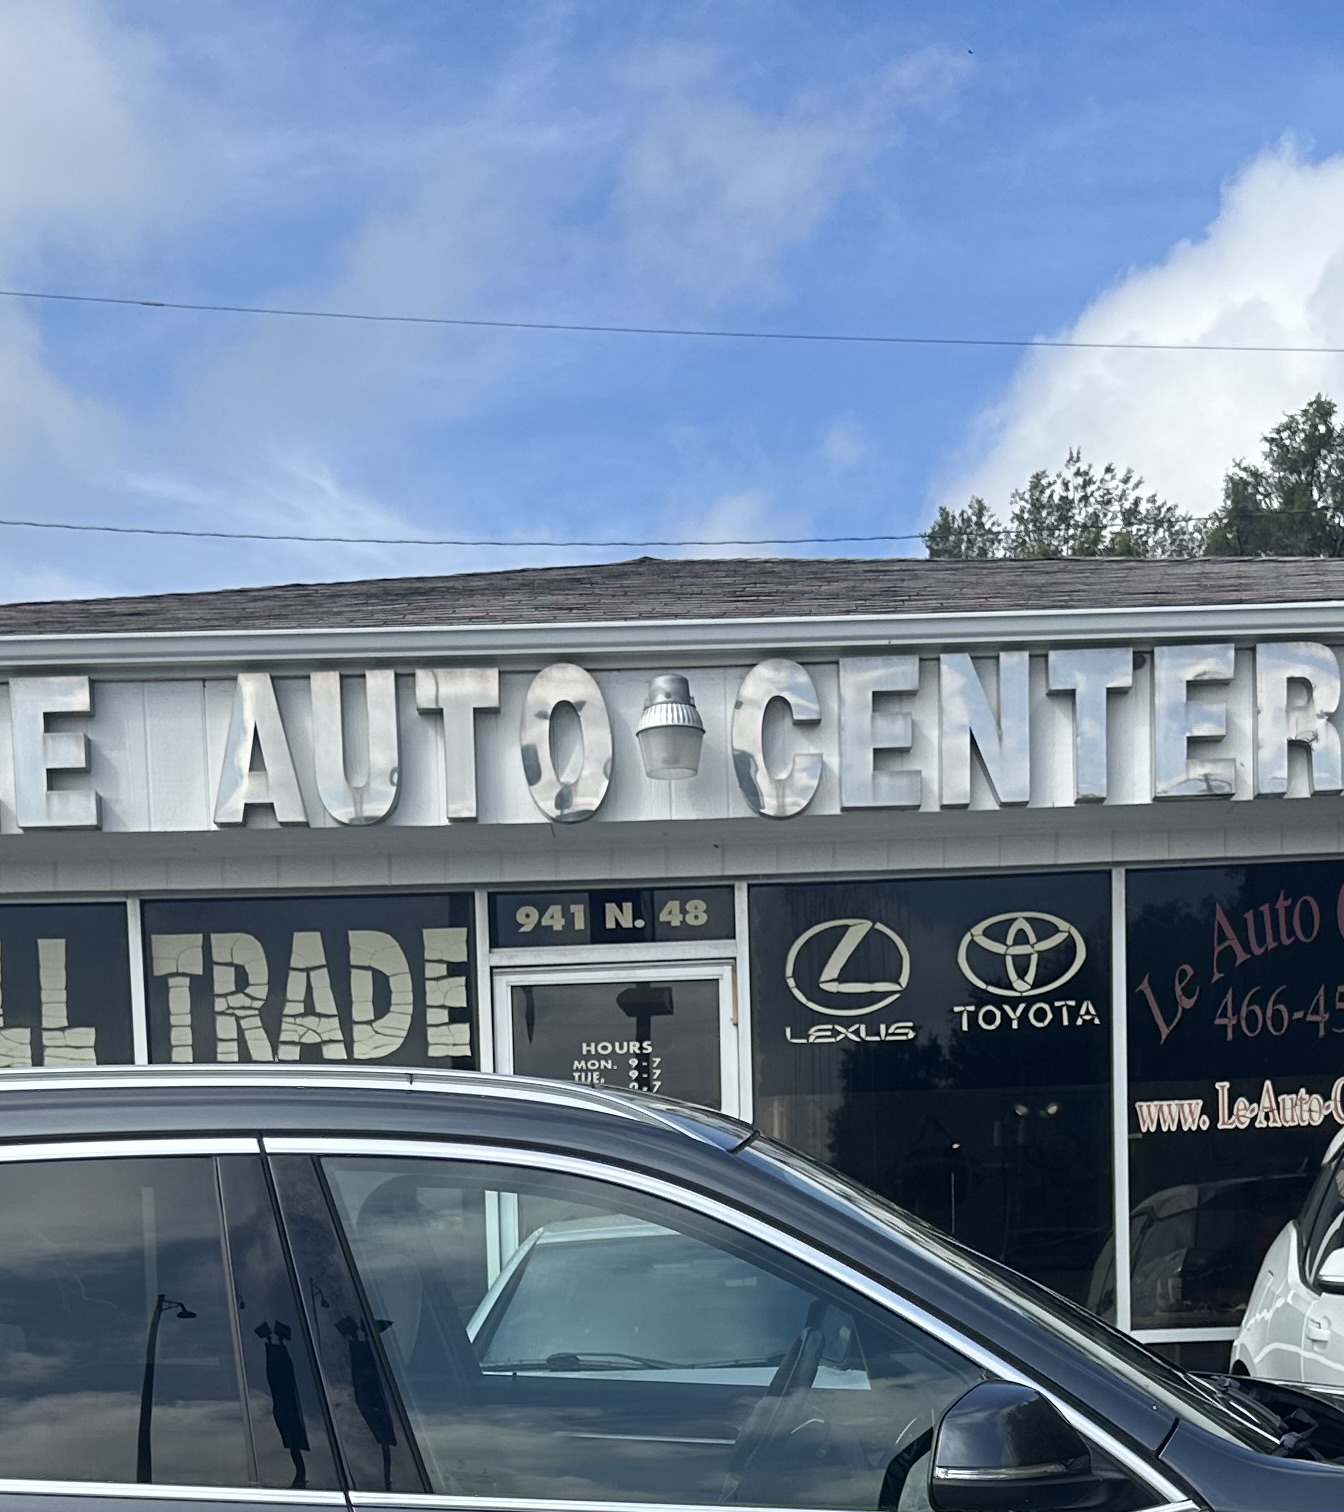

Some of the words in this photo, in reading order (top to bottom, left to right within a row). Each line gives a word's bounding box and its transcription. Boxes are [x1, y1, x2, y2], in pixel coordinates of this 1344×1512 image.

[213, 662, 613, 826] AUTO
[731, 641, 1344, 820] CENTER
[516, 904, 585, 932] 941
[605, 902, 646, 928] N.
[659, 900, 708, 927] 48
[1135, 963, 1201, 1045] Le
[1211, 889, 1320, 984] Auto
[150, 928, 471, 1063] TRADE
[953, 1000, 1101, 1032] TOYOTA
[582, 1041, 653, 1055] HOURS
[785, 1021, 916, 1044] LEXUS
[572, 1059, 618, 1070] MON.
